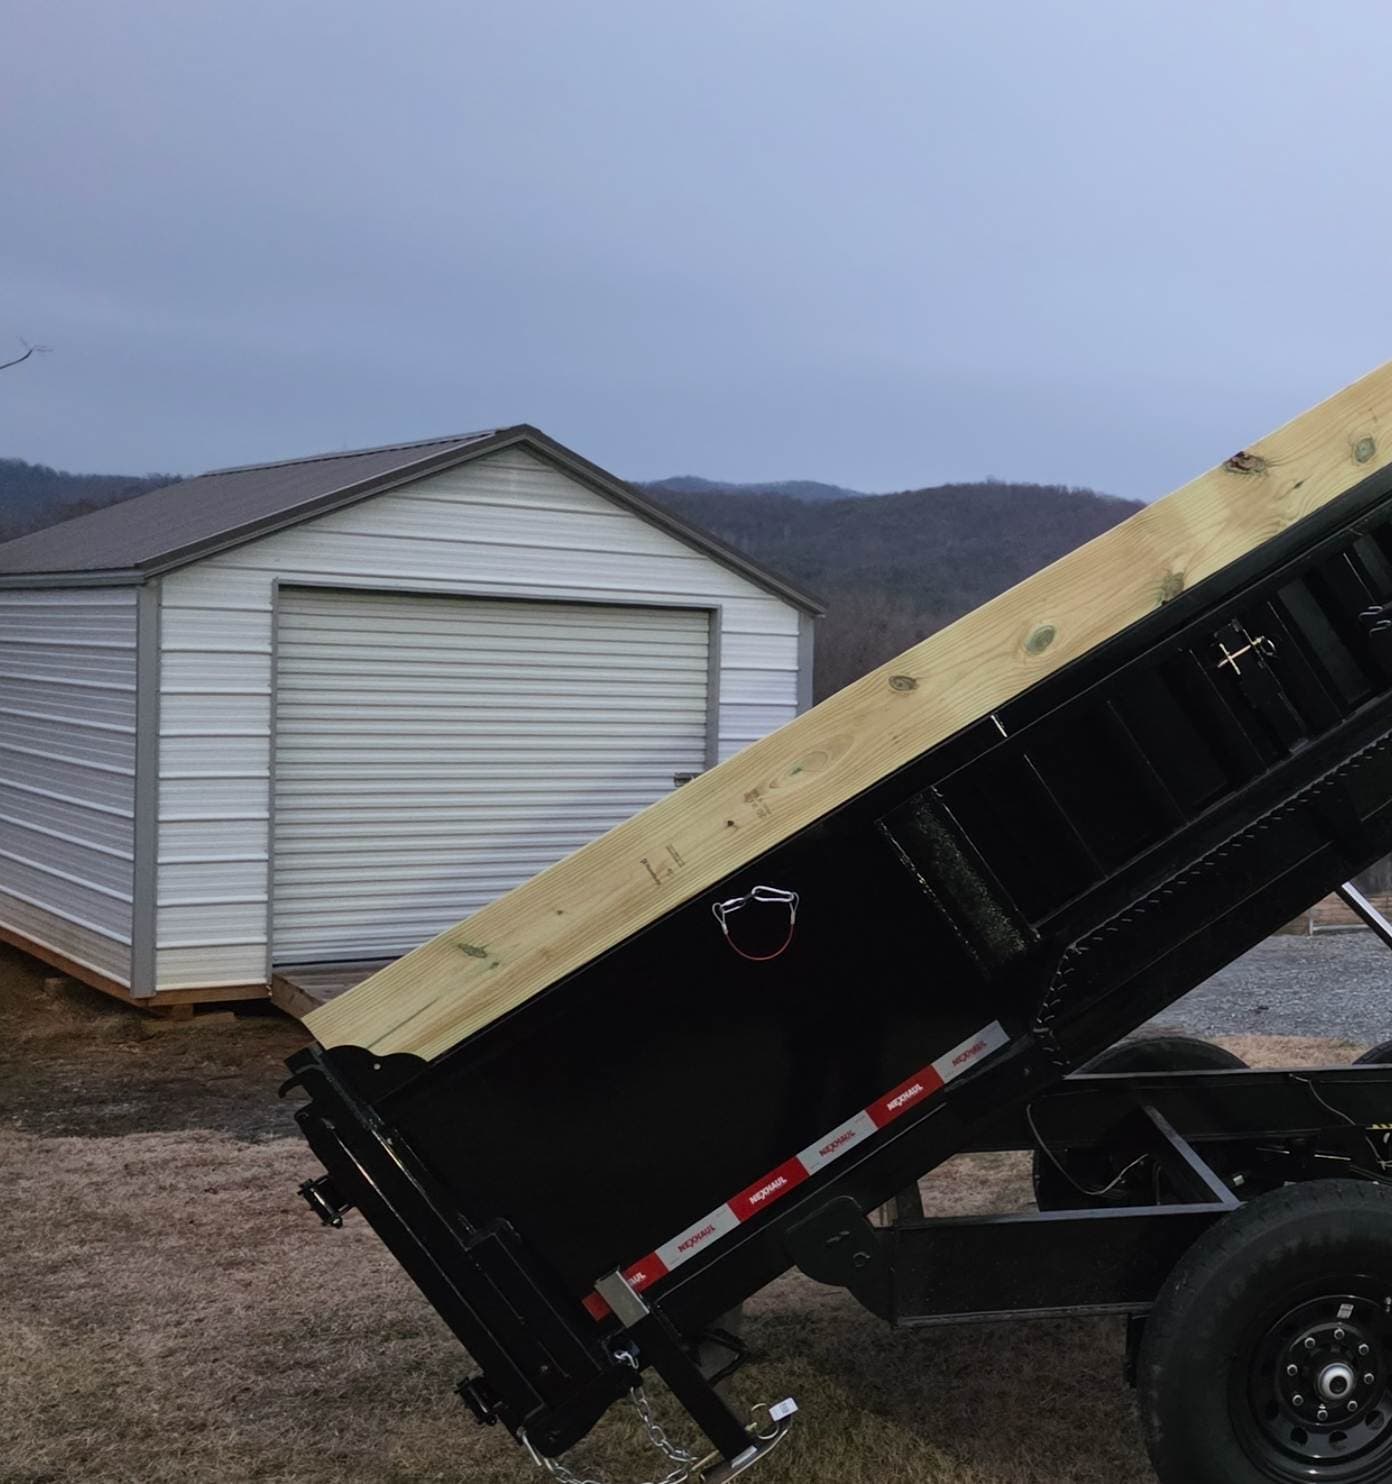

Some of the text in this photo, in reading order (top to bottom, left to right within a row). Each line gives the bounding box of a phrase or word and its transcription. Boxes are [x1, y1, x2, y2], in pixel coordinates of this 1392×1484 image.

[819, 1129, 856, 1156] NEXHAUL
[748, 1176, 787, 1204] NEXHAUL
[677, 1225, 716, 1252] NEXHAUL
